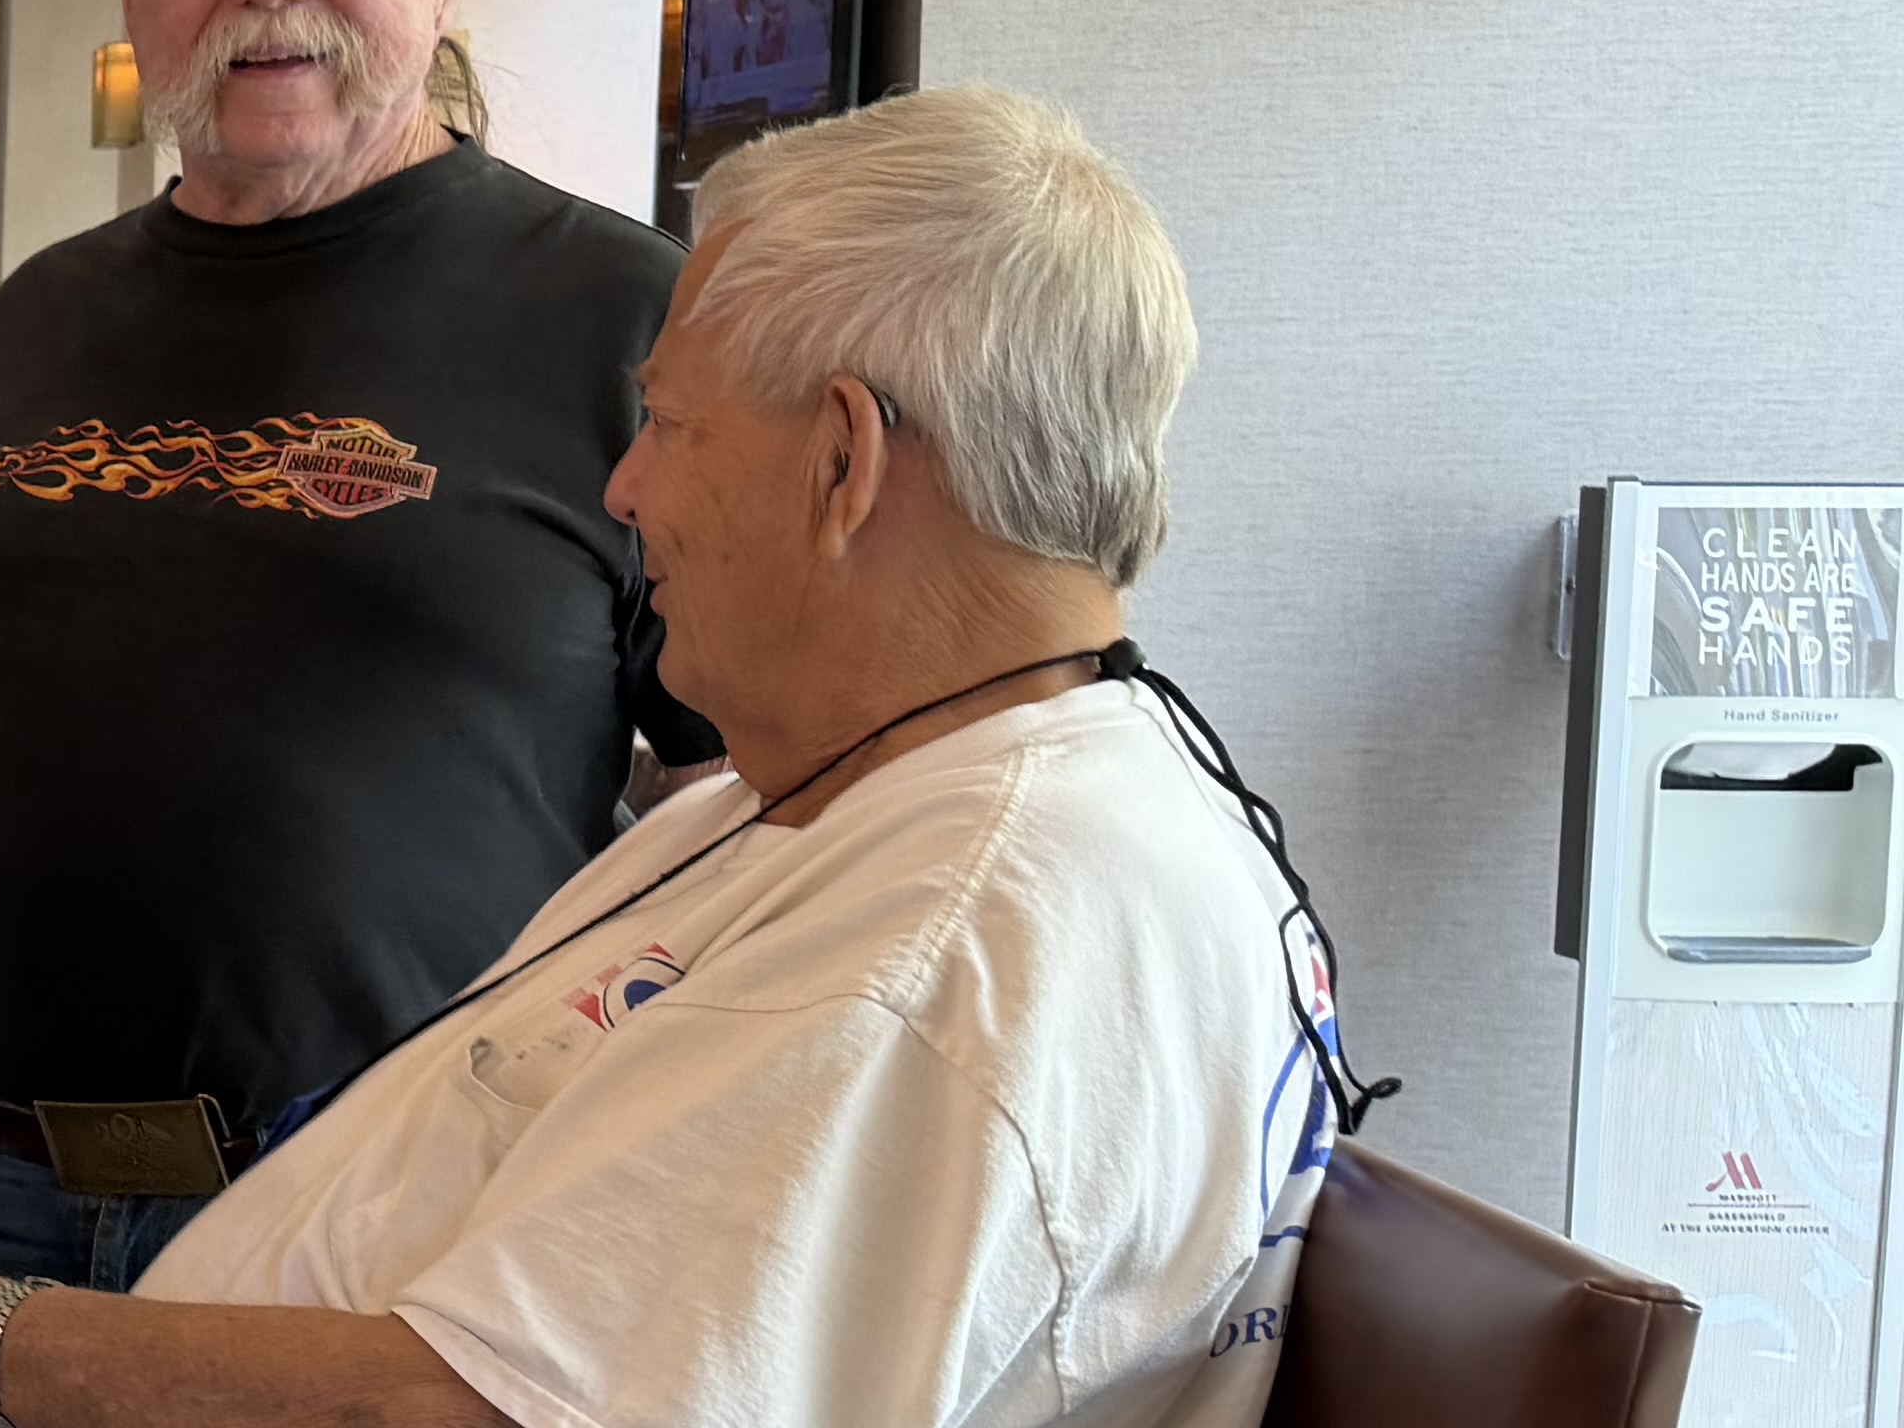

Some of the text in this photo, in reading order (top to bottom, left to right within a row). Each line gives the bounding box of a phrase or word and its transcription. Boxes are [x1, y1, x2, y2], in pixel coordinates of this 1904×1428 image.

[326, 436, 399, 459] MOTOR
[289, 452, 424, 488] HARLEY-DAVIDSON
[312, 478, 387, 505] CYCLES
[1703, 528, 1857, 558] CLEAN
[1701, 562, 1857, 593] HANDS ARE
[1700, 596, 1853, 633] SAFE
[1698, 635, 1852, 666] HANDS
[1723, 708, 1839, 722] Hand Sanitizer
